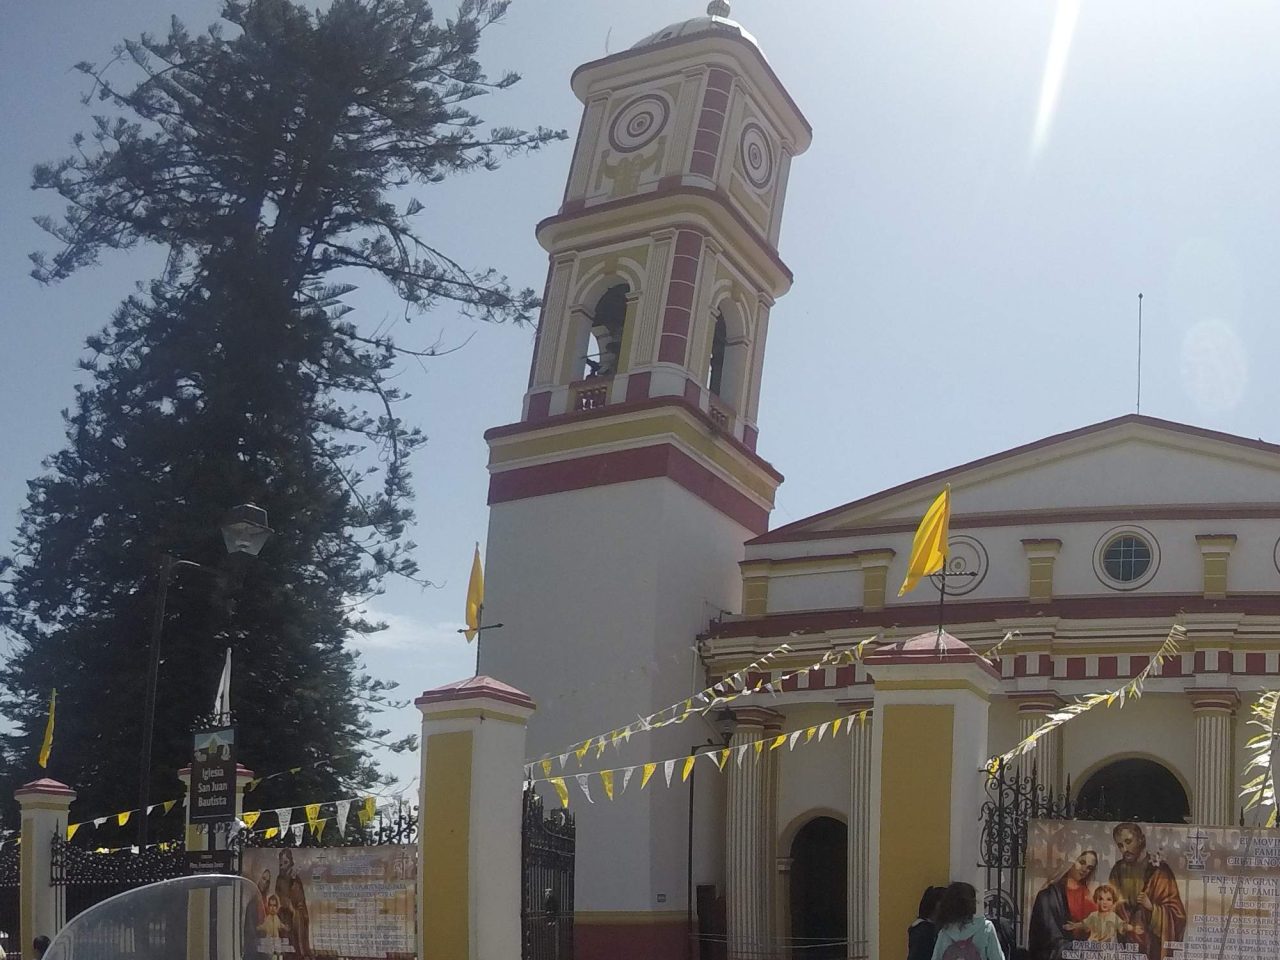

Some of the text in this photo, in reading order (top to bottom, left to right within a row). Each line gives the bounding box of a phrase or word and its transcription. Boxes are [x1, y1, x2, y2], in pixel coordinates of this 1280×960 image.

[202, 766, 224, 780] Iglesia
[198, 782, 227, 792] San Juan
[198, 795, 227, 807] Bautista
[1227, 857, 1277, 866] CRISTIANO
[1252, 877, 1278, 886] GRAN
[1218, 886, 1226, 895] TI
[1238, 887, 1249, 895] TU
[1073, 941, 1139, 952] PARROQUIA DE
[1062, 950, 1080, 960] SAN
[1081, 951, 1105, 960] JUAN
